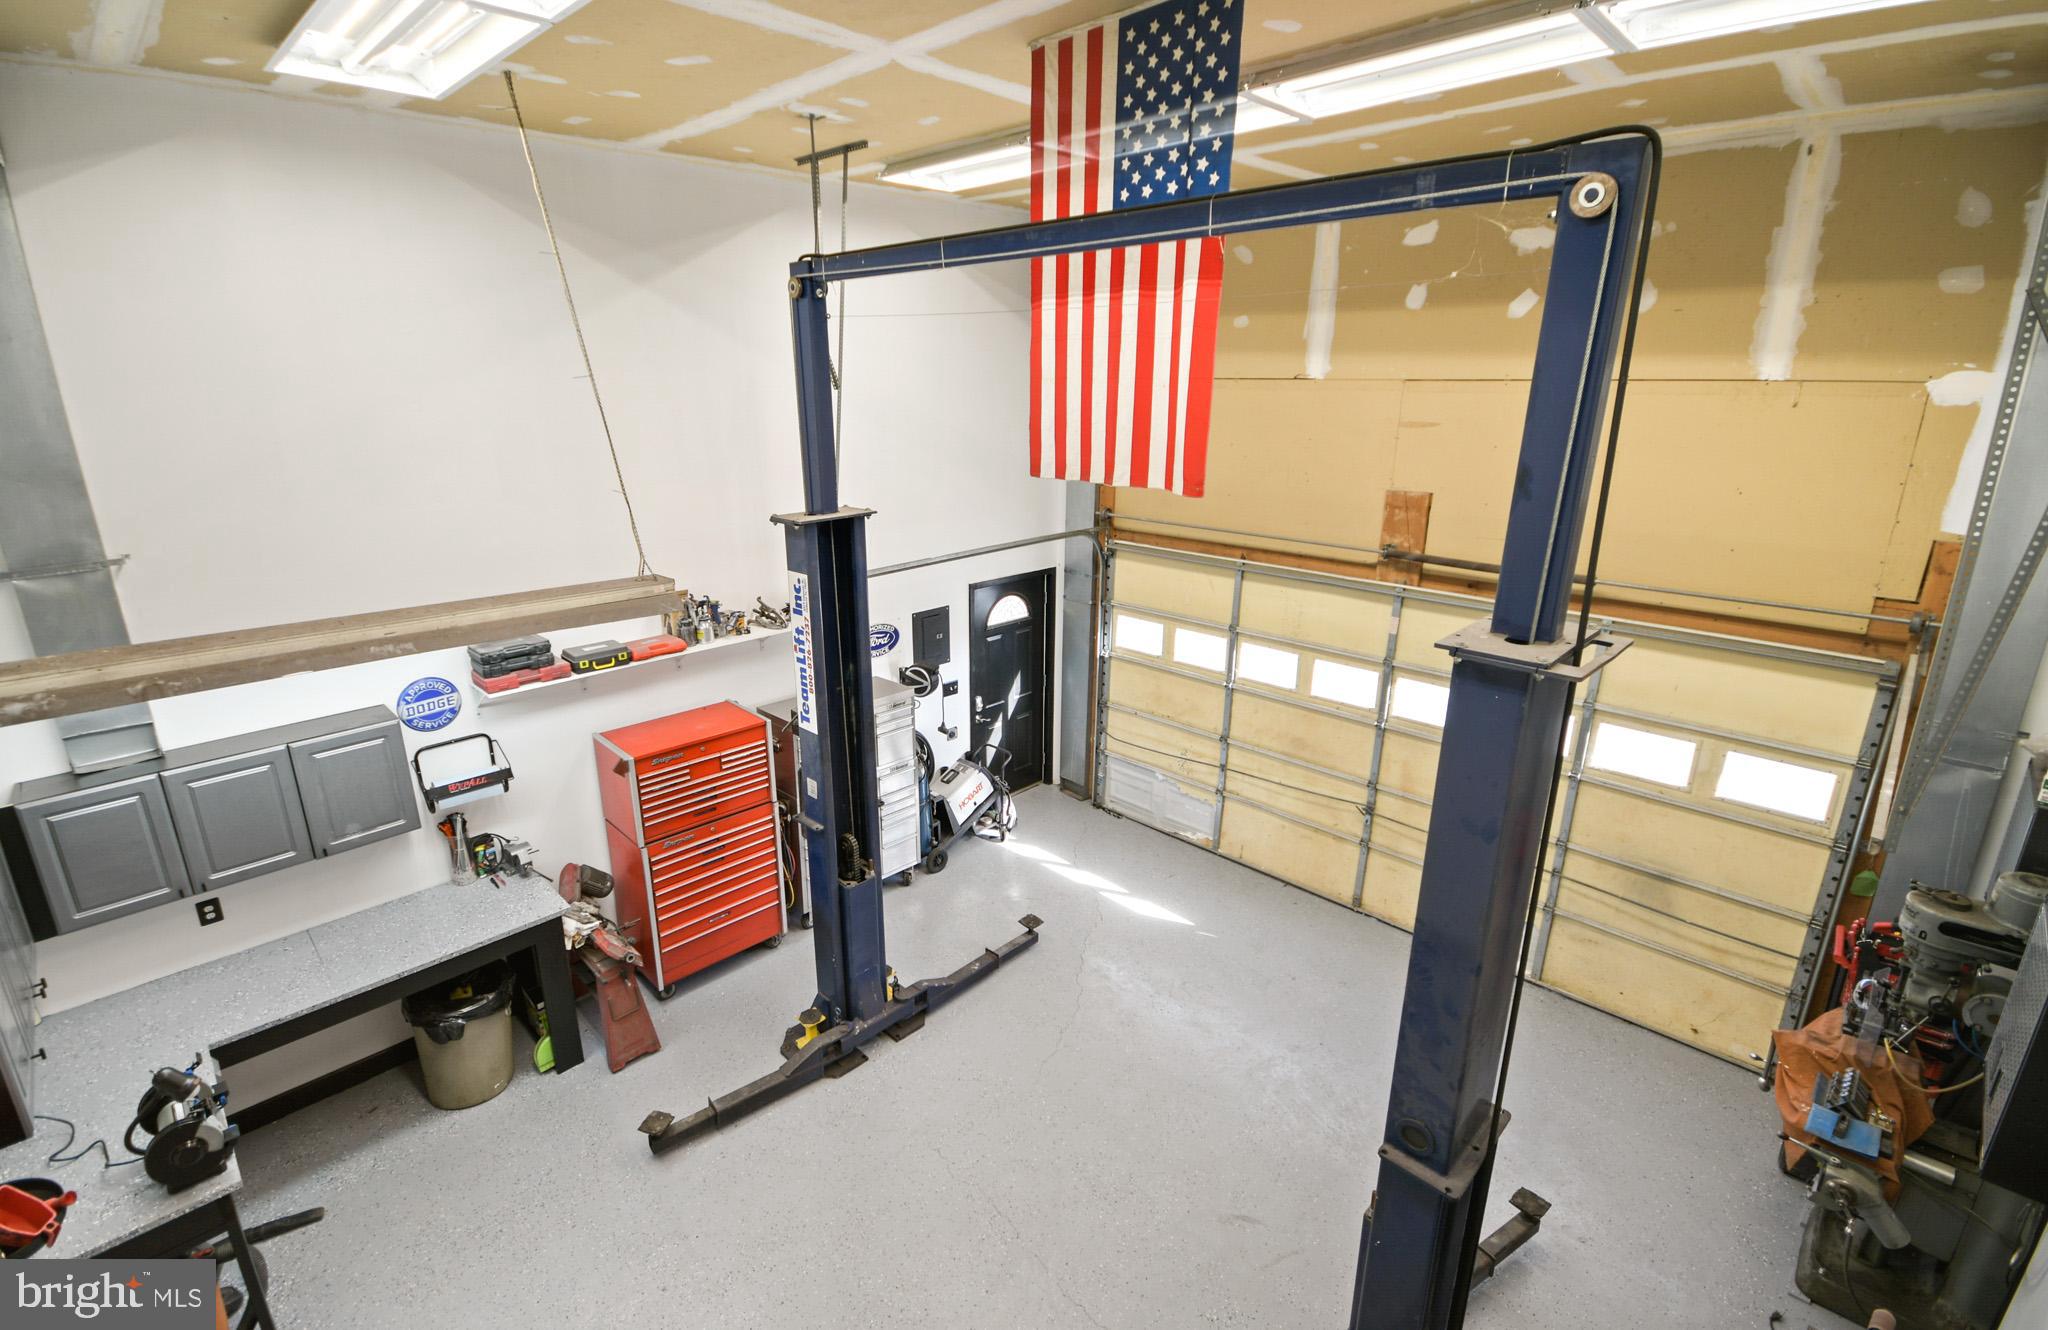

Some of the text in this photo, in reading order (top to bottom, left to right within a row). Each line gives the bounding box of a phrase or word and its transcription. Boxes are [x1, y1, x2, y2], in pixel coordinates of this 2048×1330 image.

[793, 578, 803, 616] Inc.
[404, 681, 452, 703] APPROVED
[406, 695, 456, 718] DODGE
[411, 711, 455, 729] SERVICE
[959, 783, 985, 810] HOBART
